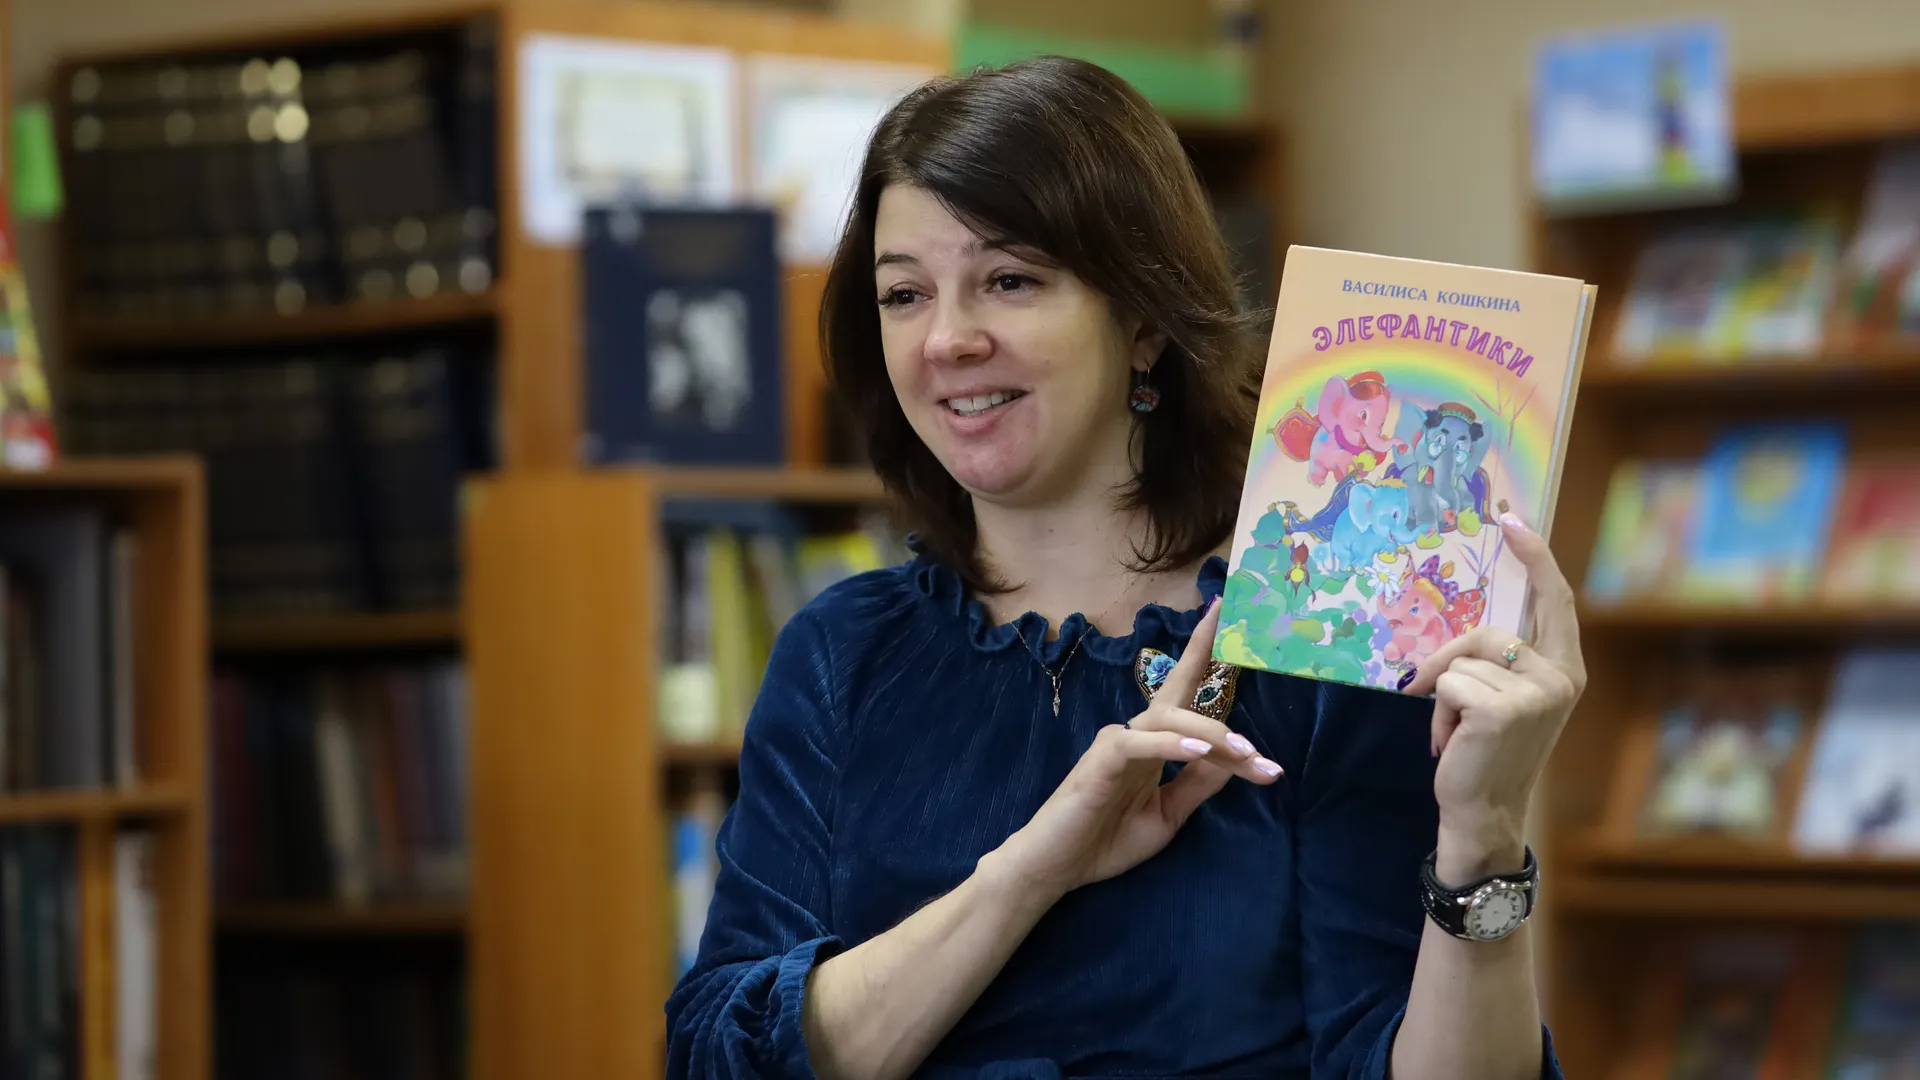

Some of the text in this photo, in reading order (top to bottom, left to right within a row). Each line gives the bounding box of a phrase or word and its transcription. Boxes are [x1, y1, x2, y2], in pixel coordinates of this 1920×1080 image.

[1342, 279, 1521, 312] ВАСИЛИСА КОШКИНА
[1312, 314, 1534, 378] ЭЛЕФАНТИКИ
